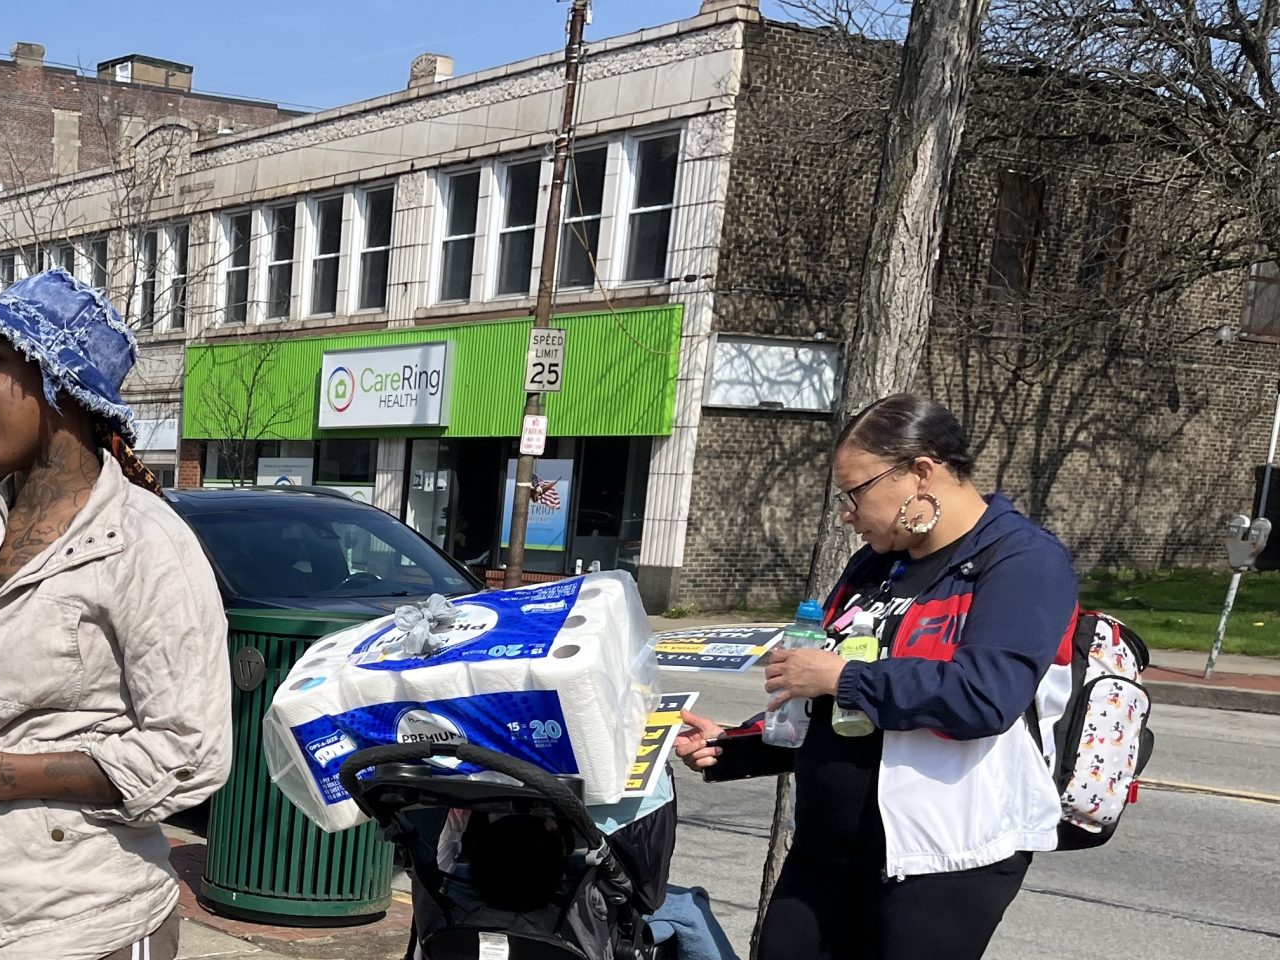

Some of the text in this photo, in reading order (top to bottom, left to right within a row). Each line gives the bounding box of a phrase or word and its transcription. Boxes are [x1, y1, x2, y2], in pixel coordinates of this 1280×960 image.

[533, 333, 564, 346] SPEED
[535, 348, 559, 358] LIMIT
[360, 363, 441, 396] CareRing
[530, 362, 559, 385] 25
[379, 393, 418, 408] HEALTH
[489, 644, 523, 656] 20
[506, 722, 520, 731] 15
[529, 720, 562, 739] 20
